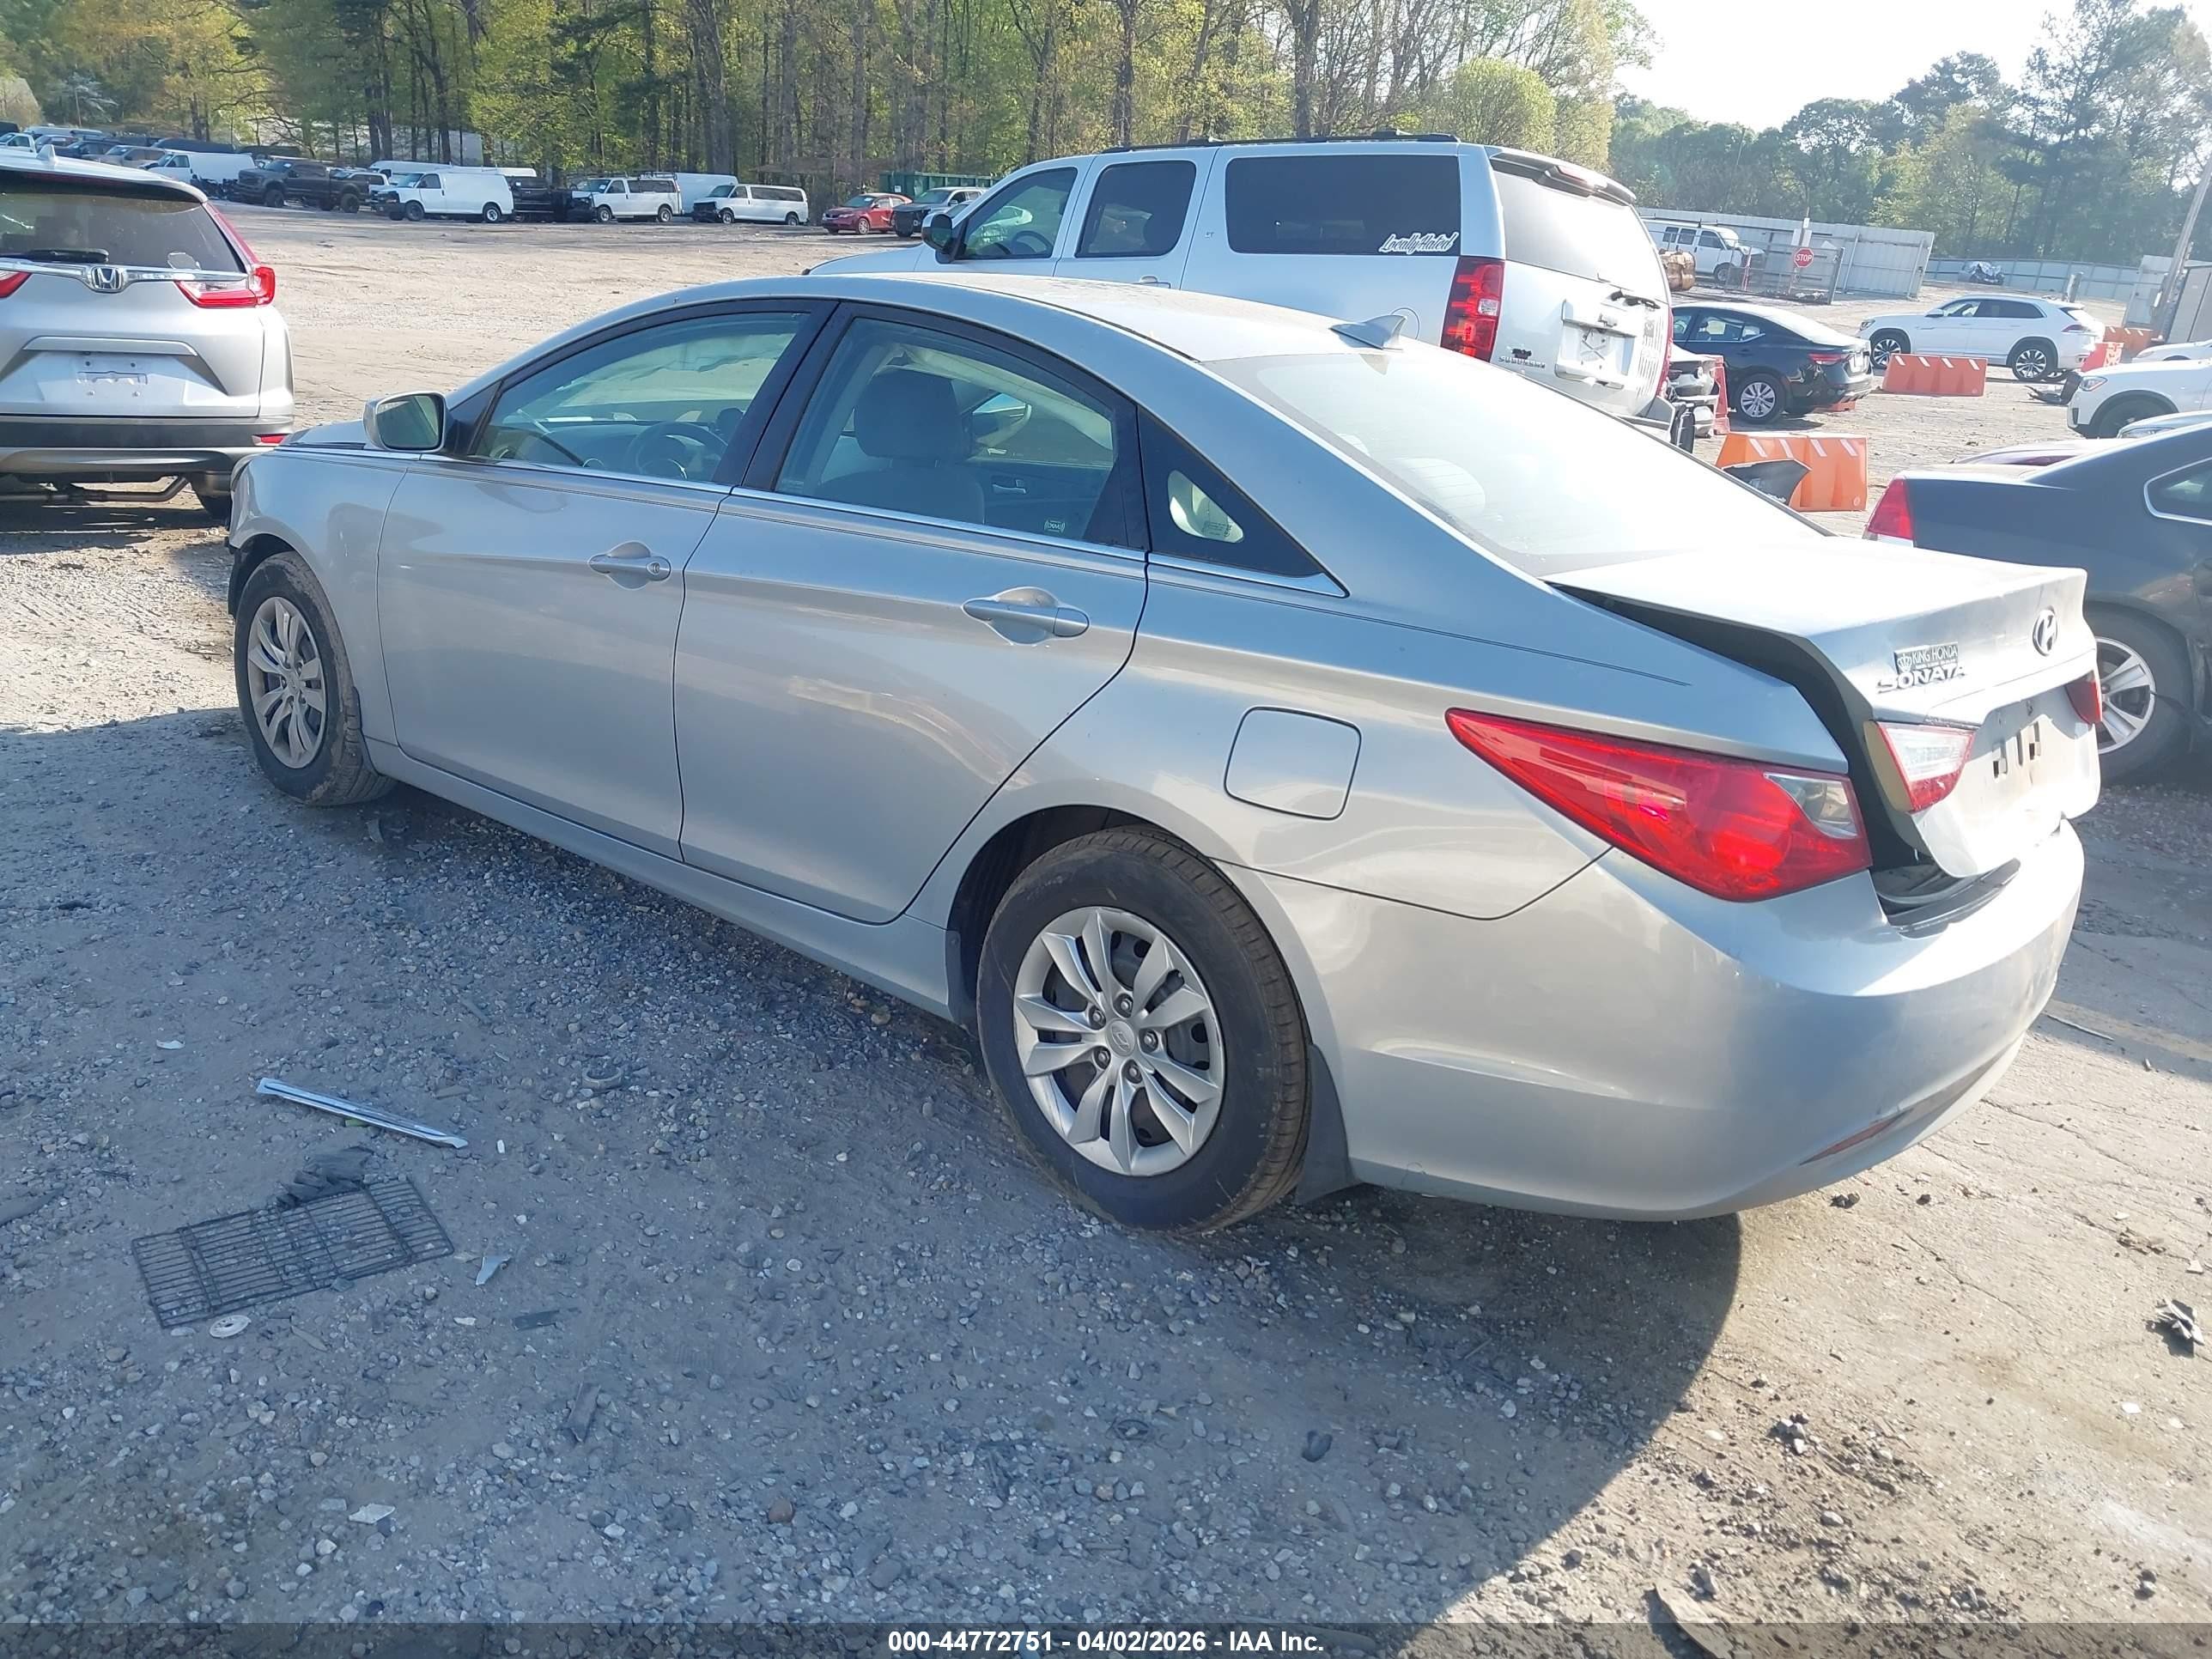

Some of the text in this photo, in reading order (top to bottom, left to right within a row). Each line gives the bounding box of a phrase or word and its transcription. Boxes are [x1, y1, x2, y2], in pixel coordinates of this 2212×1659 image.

[1796, 253, 1813, 262] STOP
[1911, 650, 1931, 665] KING
[1931, 645, 1958, 661] HONDA
[1876, 664, 1966, 694] SONATA
